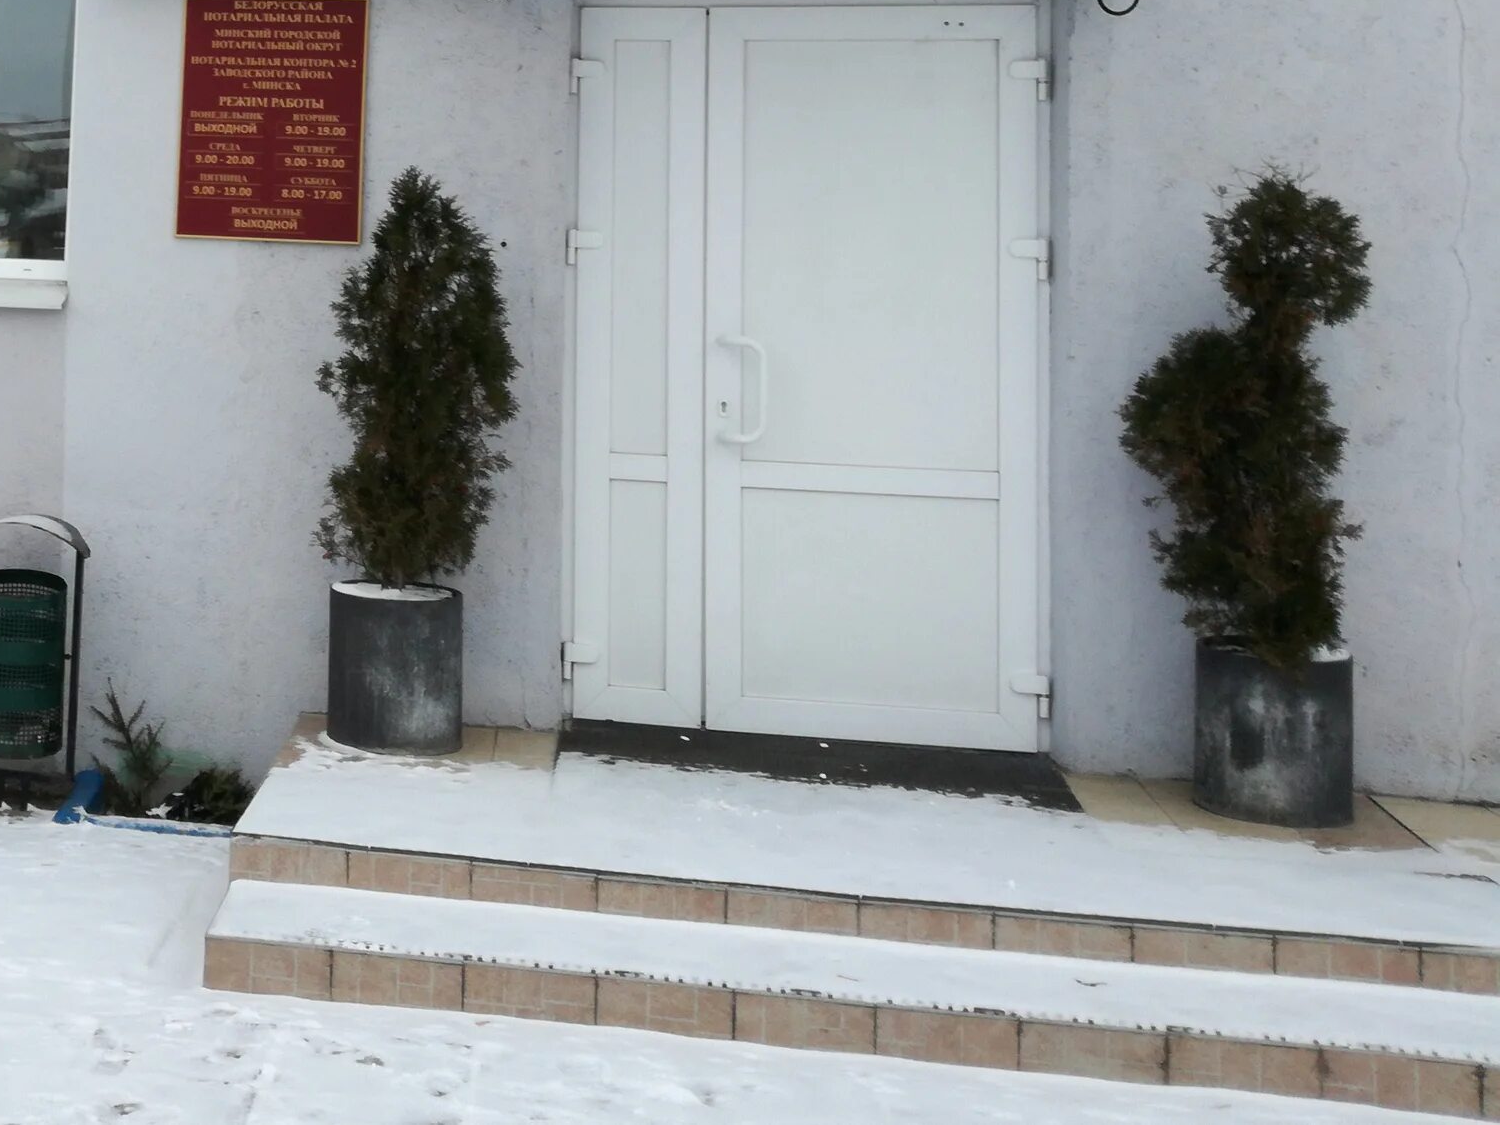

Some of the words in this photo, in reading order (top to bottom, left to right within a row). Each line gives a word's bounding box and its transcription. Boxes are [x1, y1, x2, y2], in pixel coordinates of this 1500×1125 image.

[234, 1, 324, 11] БЕЛОРУССКАЯ
[204, 12, 301, 23] НОТАРИАЛЬНАЯ
[304, 14, 353, 23] ПАЛАТА
[215, 29, 271, 38] МИНСКИЙ
[274, 29, 340, 40] ГОРОДСКОЙ
[212, 40, 304, 51] НОТАРИАЛЬНЫЙ
[307, 42, 342, 51] ОКРУГ
[191, 56, 280, 67] НОТАРИАЛЬНАЯ
[284, 58, 334, 68] КОНТОРА
[351, 60, 357, 68] 2
[213, 68, 285, 79] ЗАВОДСКОГО
[288, 69, 333, 79] РАЙОНА
[252, 81, 301, 90] МИНСКА
[219, 96, 267, 107] РЕЖИМ
[272, 97, 324, 109] РАБОТЫ
[293, 114, 340, 122] ВТОРНИК
[195, 123, 257, 134] ВЫХОДНОЙ
[285, 126, 308, 136] 9.00
[318, 127, 346, 136] 19.00
[209, 143, 240, 151] СРЕДА
[293, 145, 337, 154] ЧЕТВЕРГ
[195, 155, 218, 164] 9.00
[226, 155, 255, 165] 20.00
[284, 157, 307, 167] 9.00
[317, 159, 345, 168] 19.00
[200, 174, 248, 183] ПЯТНИЦА
[291, 177, 336, 186] СУББОТА
[193, 186, 215, 195] 9.00
[224, 187, 252, 196] 19.00
[281, 189, 304, 199] 8.00
[314, 190, 343, 200] 17.00
[231, 207, 302, 217] ВОСКРЕСЕНЬЕ
[234, 219, 298, 230] ВЫХОДНОЙ
